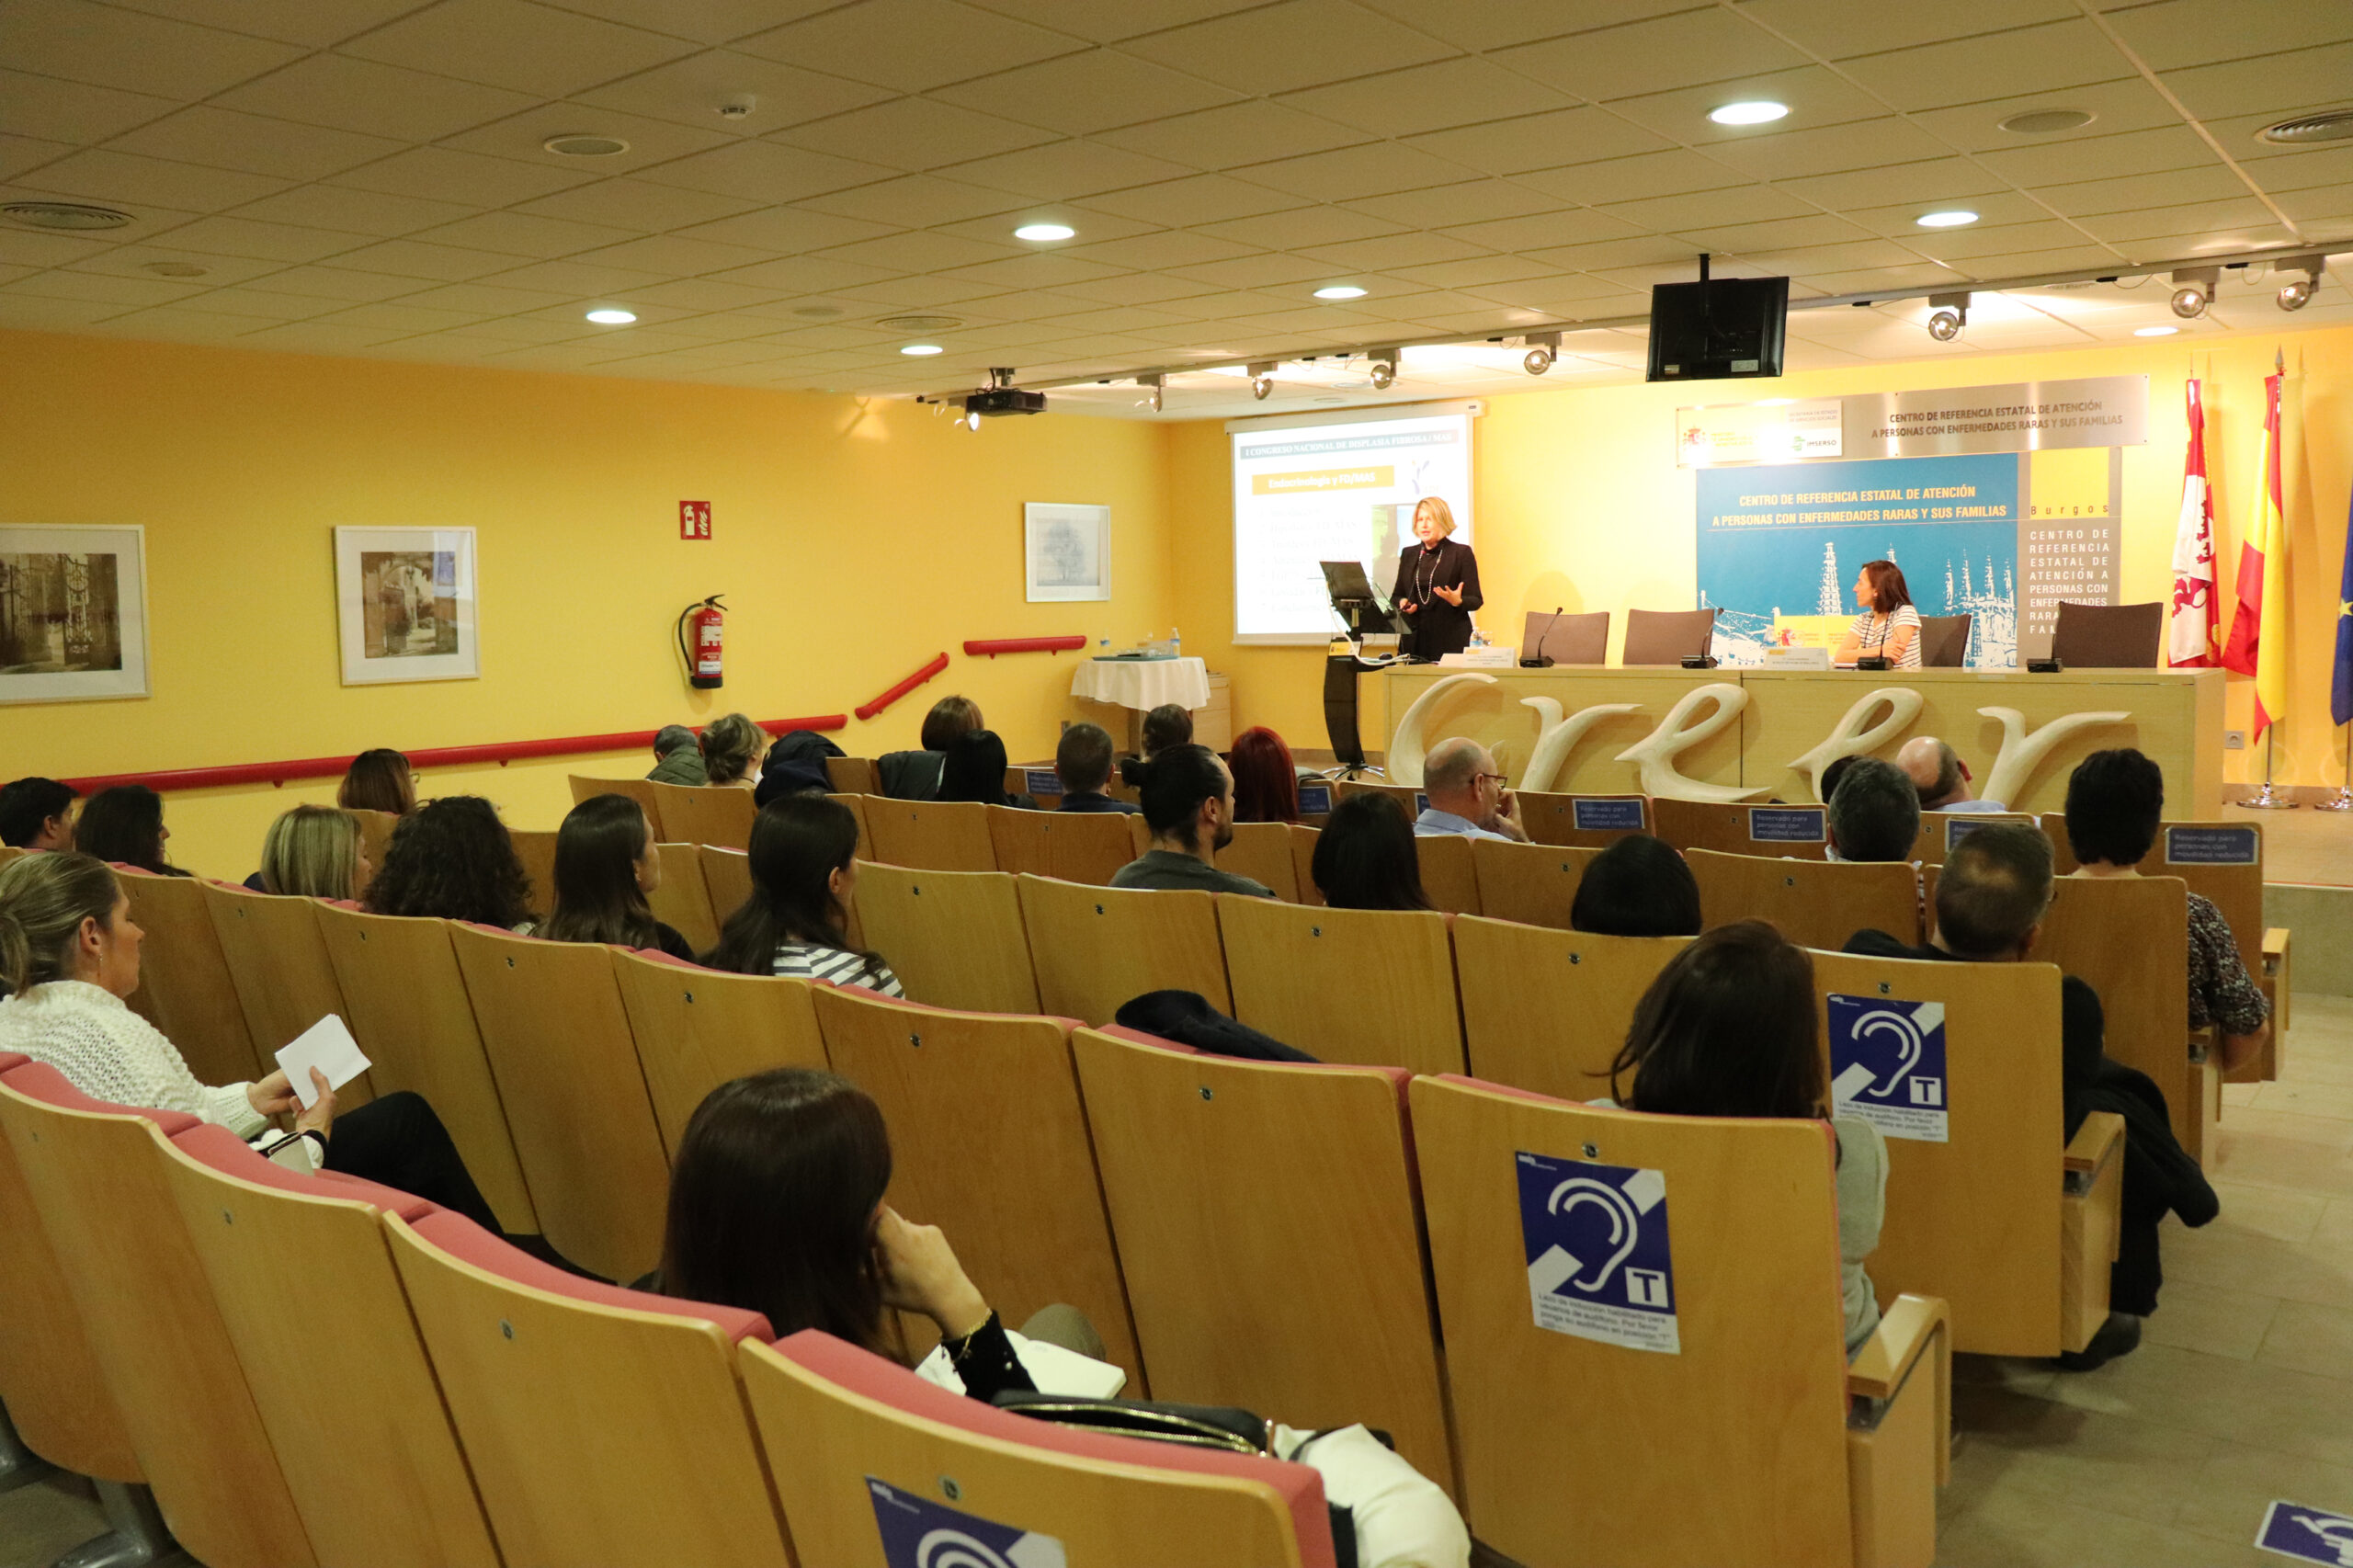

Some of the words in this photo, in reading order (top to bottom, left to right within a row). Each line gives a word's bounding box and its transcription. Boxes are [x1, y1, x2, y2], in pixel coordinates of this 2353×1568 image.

[1890, 413, 1924, 423] CENTRO
[1927, 412, 1938, 421] DE
[1940, 408, 1994, 420] REFERENCIA
[1995, 405, 2036, 416] ESTATAL
[2038, 404, 2051, 414] DE
[2052, 400, 2102, 413] ATENCIÓN
[1871, 429, 1878, 438] A
[1880, 426, 1924, 437] PERSONAS
[1926, 426, 1945, 435] CON
[1948, 420, 2017, 434] ENFERMEDADES
[2018, 419, 2050, 430] RARAS
[2051, 418, 2058, 428] Y
[2060, 417, 2077, 427] SUS
[2079, 415, 2123, 426] FAMILIAS
[1250, 445, 1293, 456] CONGRESO
[1294, 441, 1333, 453] NACIONAL
[1336, 441, 1347, 449] DE
[1348, 437, 1391, 449] DISPLASIA
[1435, 433, 1453, 441] MAS
[1330, 477, 1338, 486] y
[1339, 472, 1376, 485] FD/MAS
[1739, 494, 1779, 506] CENTRO
[1780, 494, 1793, 505] DE
[1796, 491, 1858, 504] REFERENCIA
[1860, 489, 1903, 502] ESTATAL
[1905, 488, 1920, 500] DE
[1923, 483, 1976, 498] ATENCIÓN
[1712, 516, 1720, 527] A
[1722, 513, 1773, 526] PERSONAS
[1776, 512, 1796, 524] CON
[1799, 509, 1880, 524] ENFERMEDADES
[1882, 508, 1918, 520] RARAS
[1921, 508, 1928, 519] Y
[1931, 506, 1953, 519] SUS
[1955, 505, 2007, 517] FAMILIAS
[2030, 505, 2109, 516] Burgos
[2029, 529, 2084, 540] CENTRO
[2092, 528, 2109, 539] DE
[2029, 542, 2109, 553] REFERENCIA
[2029, 557, 2085, 567] ESTATAL
[2092, 556, 2109, 566] DE
[2029, 567, 2094, 580] ATENCIÓN
[2101, 570, 2109, 579] A
[2029, 584, 2083, 594] PERSONAS
[2086, 584, 2109, 593] CON
[2029, 611, 2059, 620] RARA
[1915, 1078, 1936, 1103] T
[1631, 1271, 1659, 1302] T
